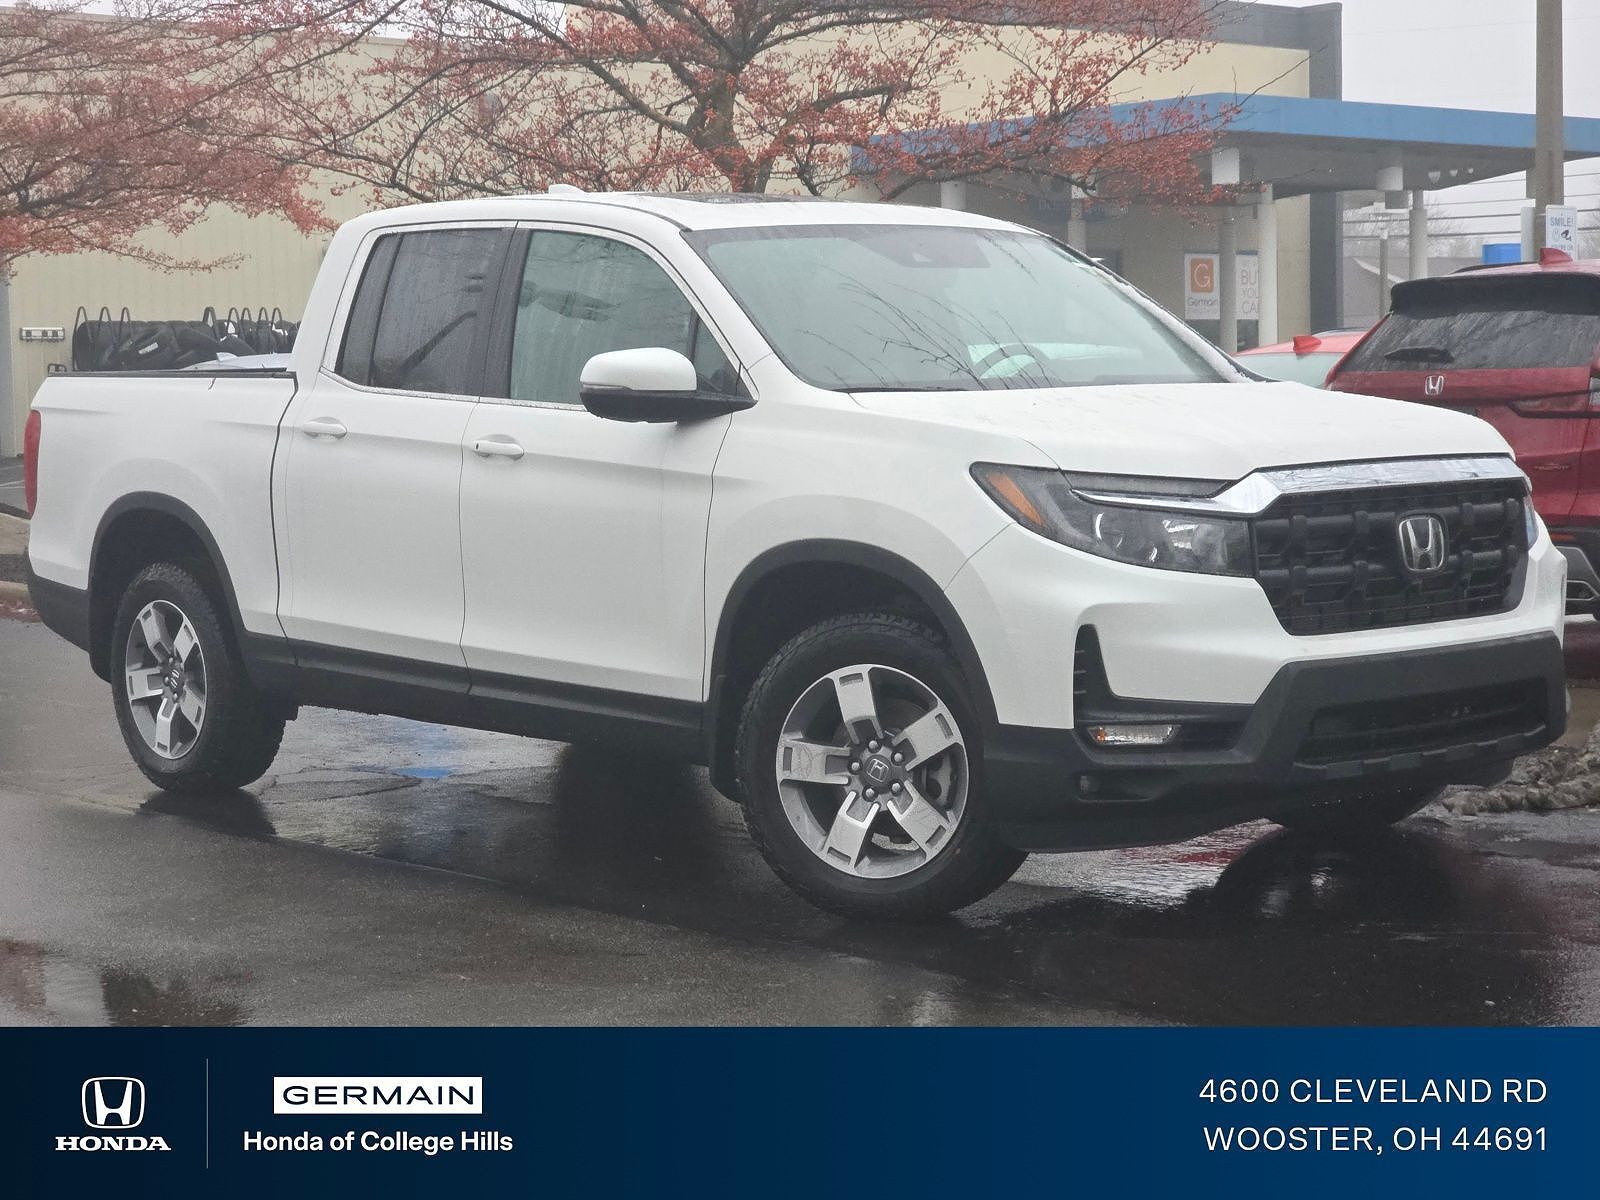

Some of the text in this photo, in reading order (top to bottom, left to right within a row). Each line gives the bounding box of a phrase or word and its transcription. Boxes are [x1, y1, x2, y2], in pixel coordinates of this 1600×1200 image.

[1194, 263, 1211, 288] G
[1240, 269, 1257, 285] BU
[1240, 287, 1259, 298] YO
[1242, 300, 1258, 314] CA
